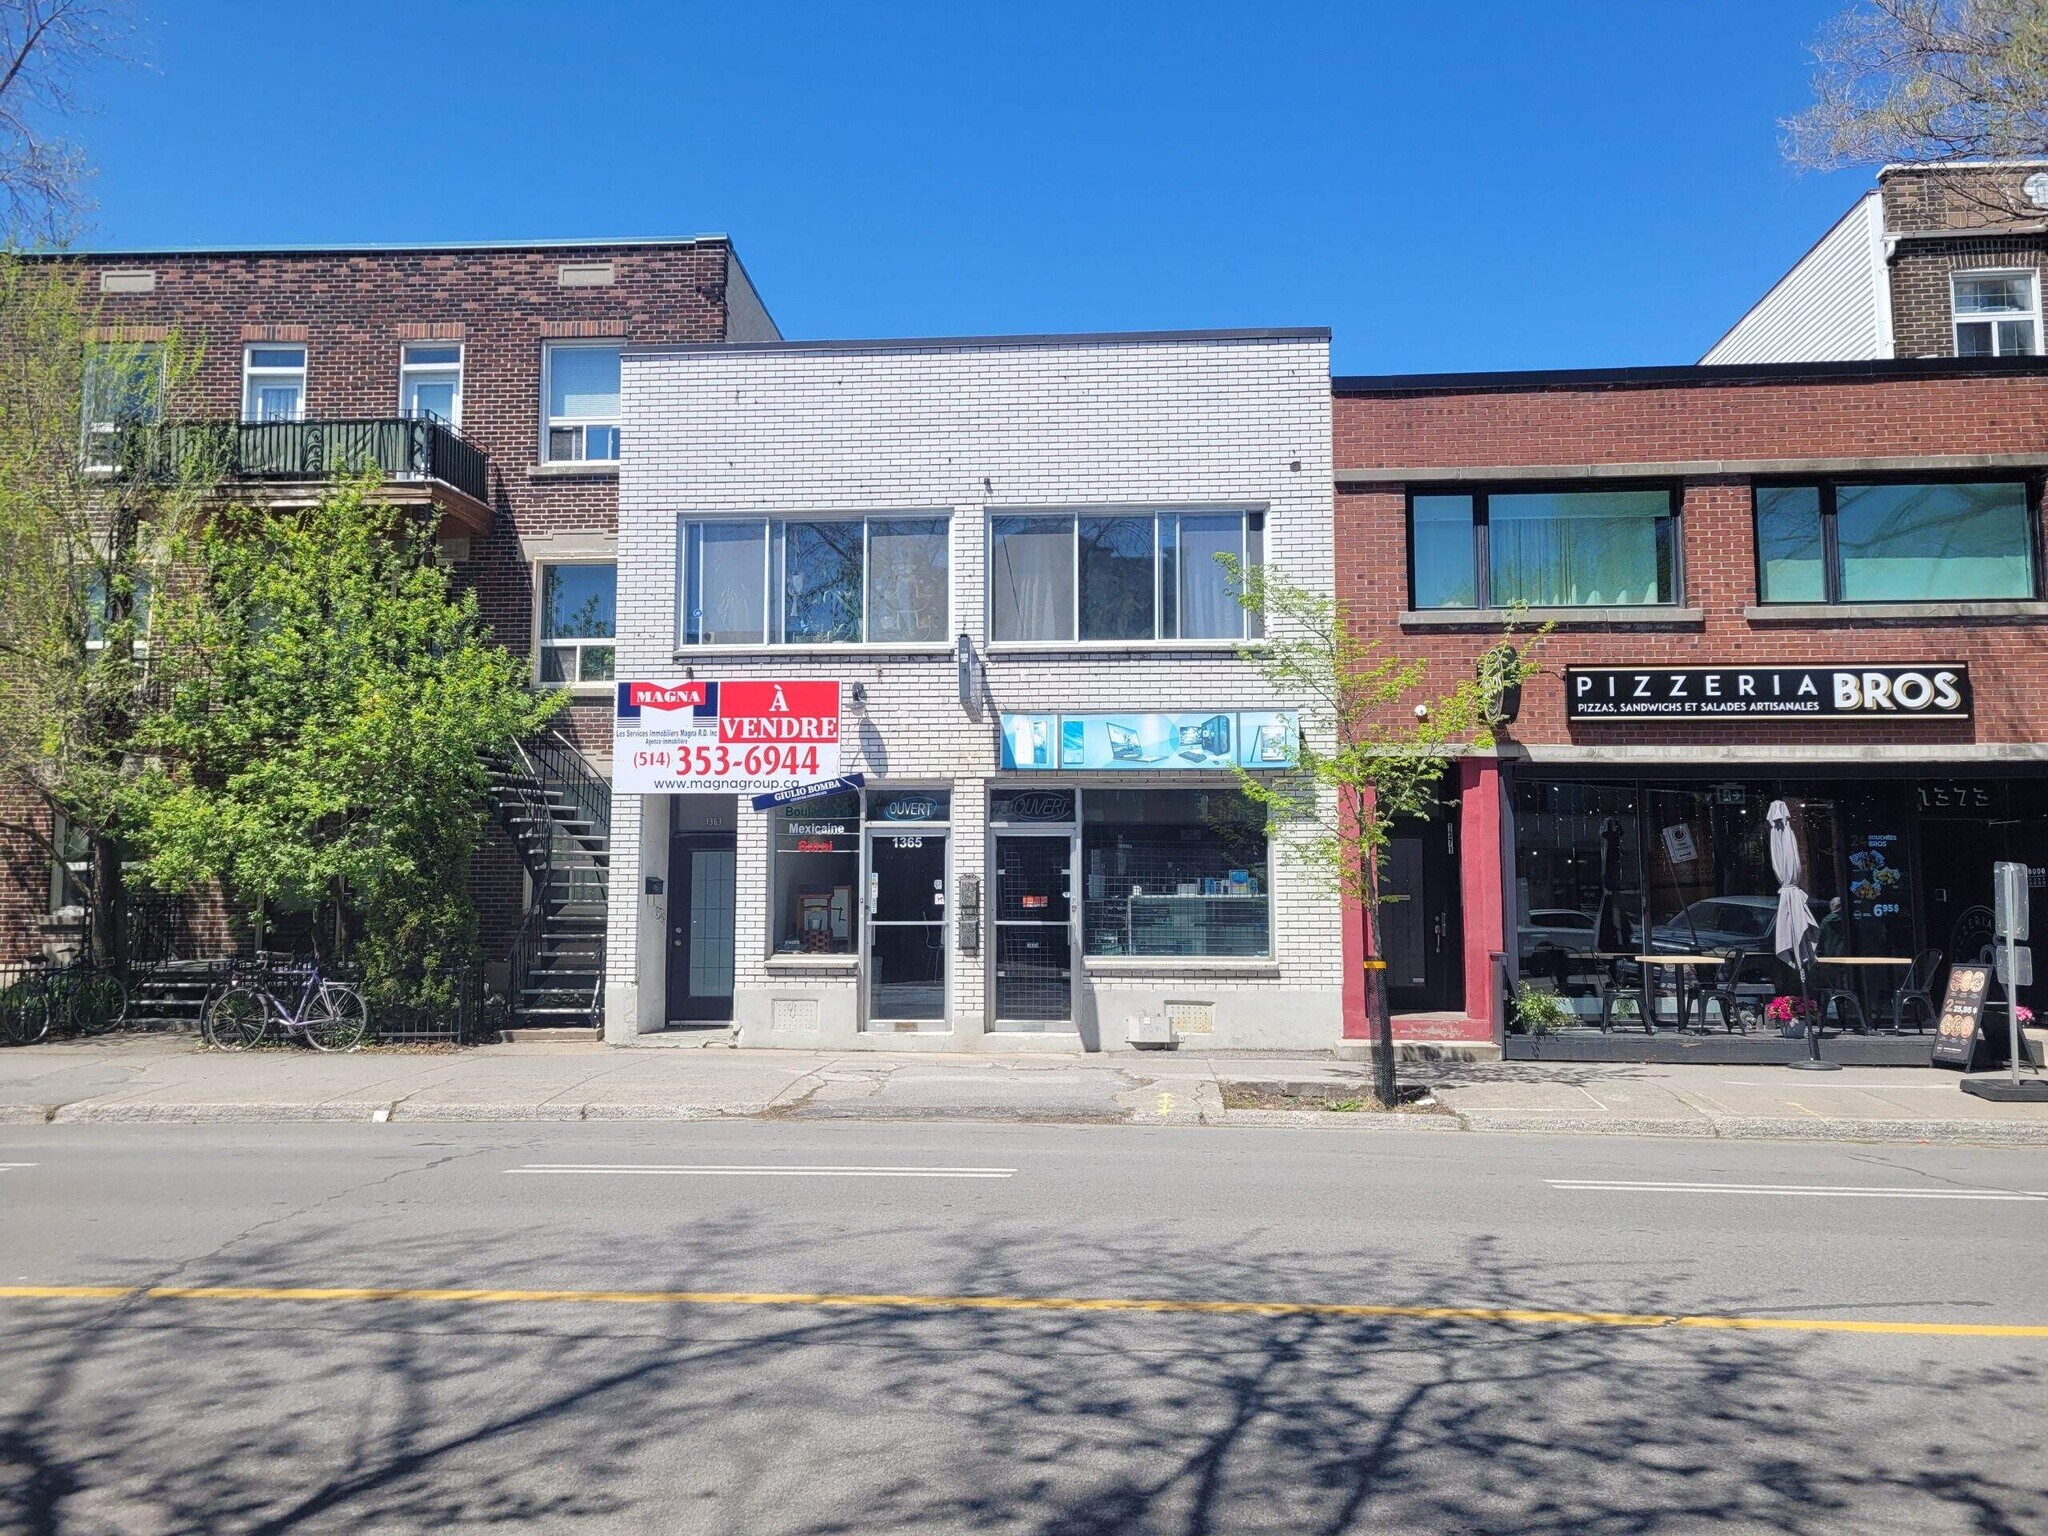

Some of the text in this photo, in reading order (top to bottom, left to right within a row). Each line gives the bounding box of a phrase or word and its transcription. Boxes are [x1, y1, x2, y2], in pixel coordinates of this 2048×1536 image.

[636, 690, 701, 703] MAGNA
[768, 684, 790, 712] À
[1576, 671, 1961, 711] PIZZERIA BROS
[1577, 701, 1820, 713] PIZZAS, SANDWICHS ET SALADES ARTISANALES
[626, 729, 649, 738] Services
[680, 729, 697, 739] Magna
[721, 717, 837, 738] VENDRE
[633, 745, 820, 776] (514) 353-6944
[653, 779, 800, 793] www.magnagroup.ca
[774, 787, 808, 801] GIULIO
[807, 779, 842, 794] BOMBA
[889, 801, 933, 816] OUVERT
[1014, 798, 1070, 815] OUVERT
[789, 822, 845, 835] Mexicaine
[892, 837, 923, 849] 1365
[1945, 998, 1955, 1012] 2
